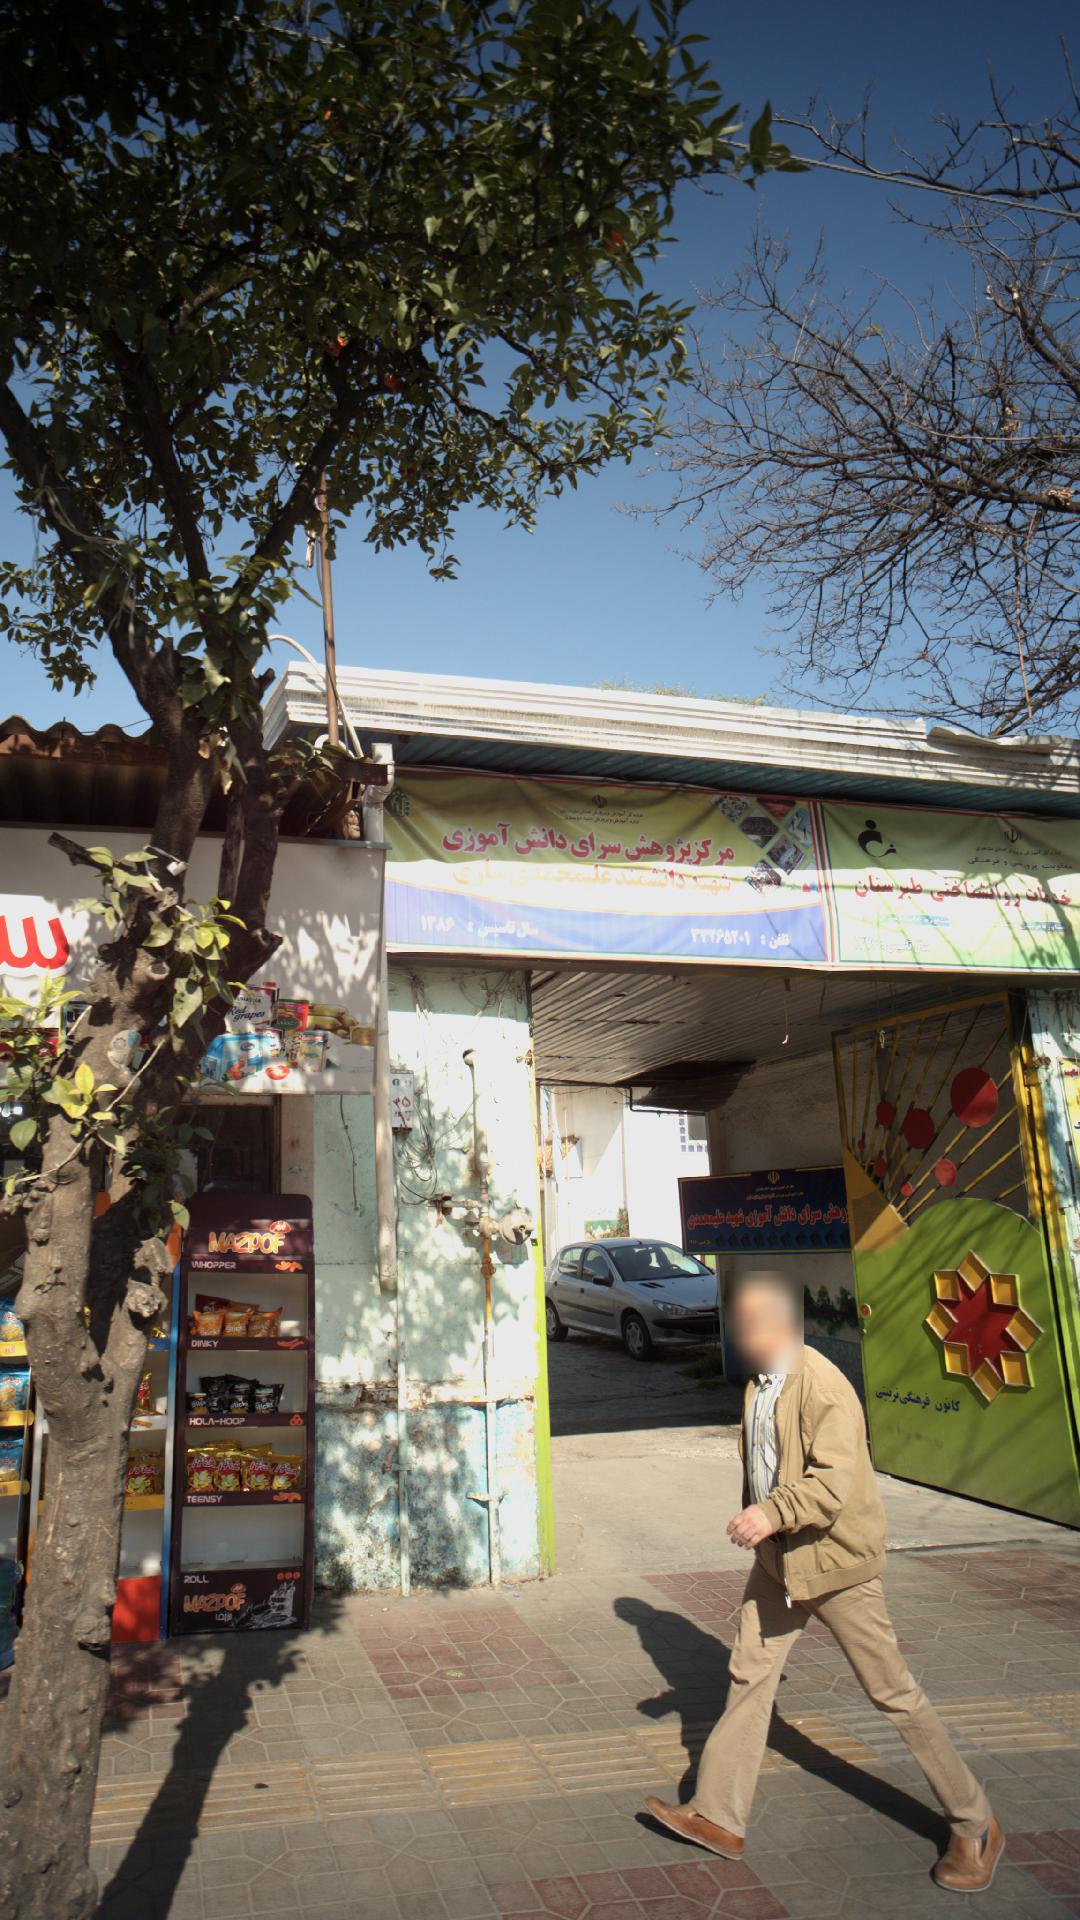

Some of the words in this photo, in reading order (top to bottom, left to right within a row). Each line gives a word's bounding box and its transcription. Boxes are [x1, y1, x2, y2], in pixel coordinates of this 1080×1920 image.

[441, 821, 511, 852] آموزی
[514, 828, 567, 856] دانش
[570, 831, 622, 861] سرای
[191, 1260, 237, 1270] WHOPPER
[191, 1339, 218, 1348] DINKY
[900, 1392, 931, 1409] فرهنگی
[935, 1397, 961, 1413] کانون
[189, 1417, 246, 1426] HOLA-HOOP
[186, 1495, 222, 1503] TEENSY
